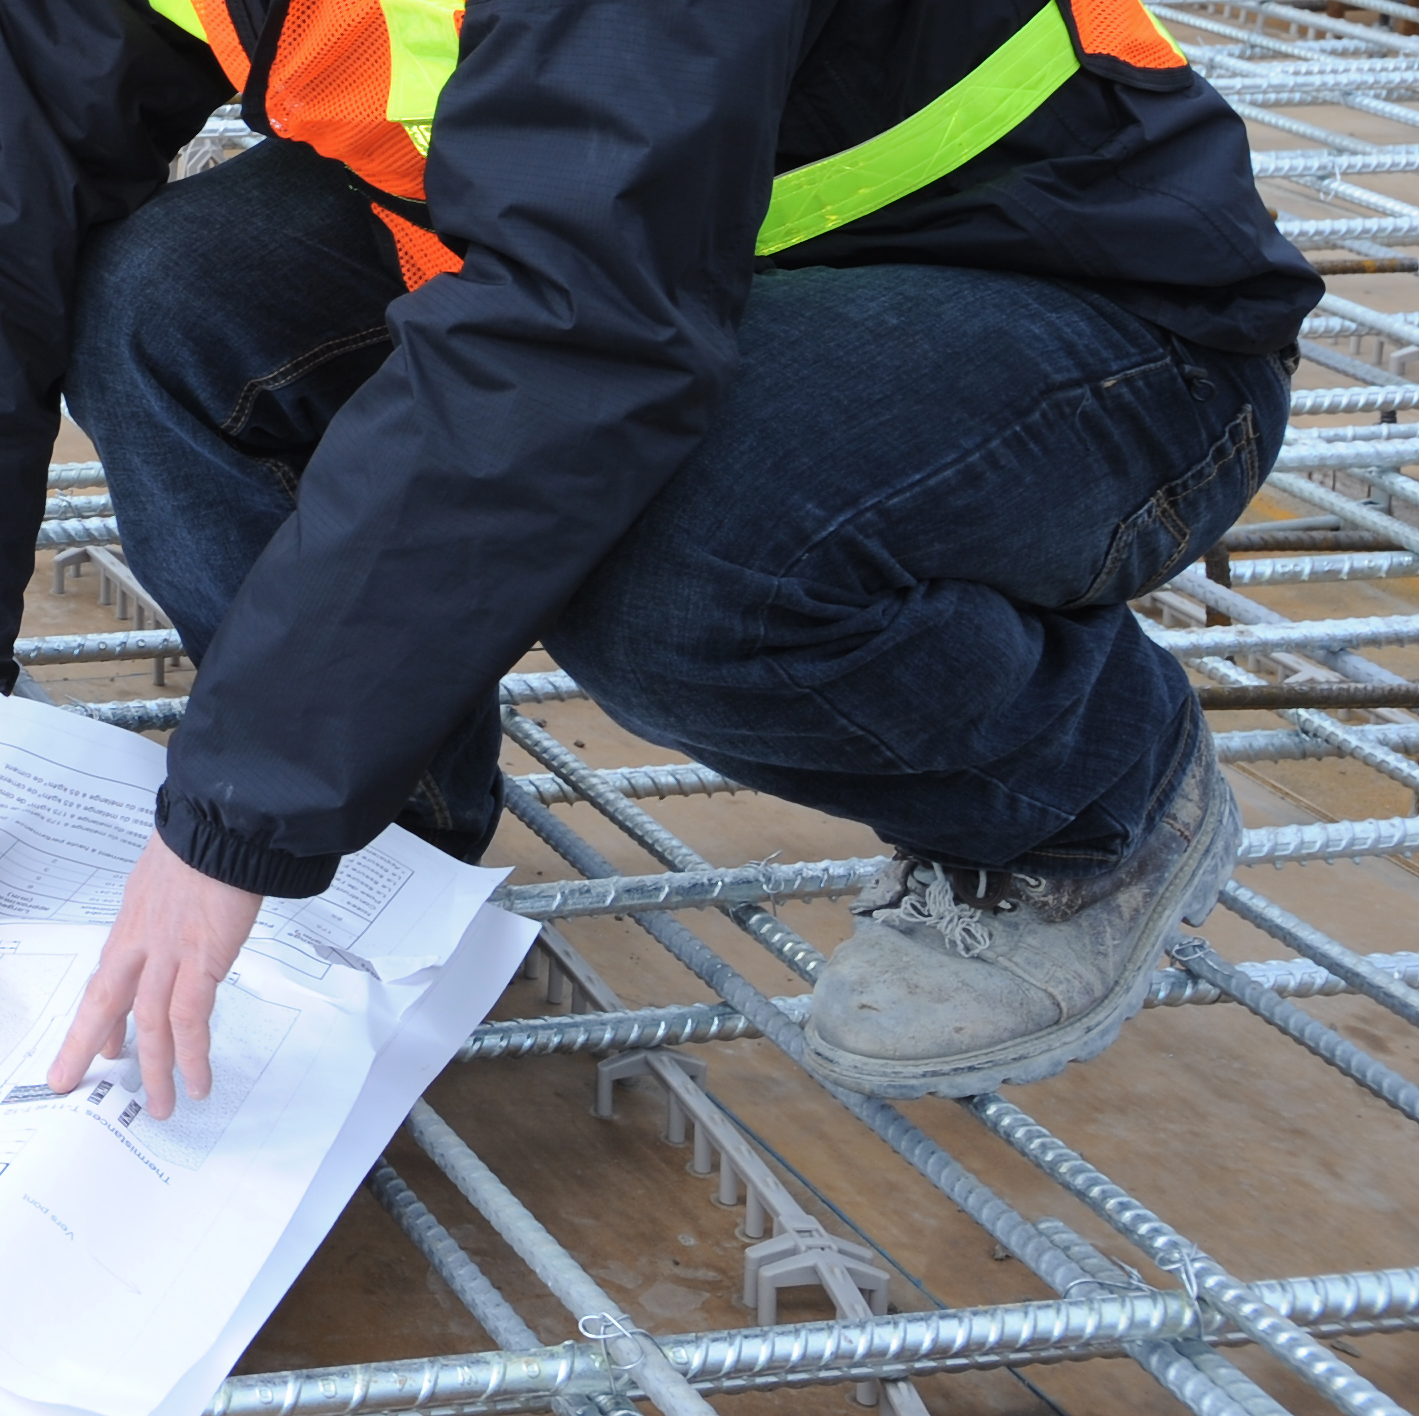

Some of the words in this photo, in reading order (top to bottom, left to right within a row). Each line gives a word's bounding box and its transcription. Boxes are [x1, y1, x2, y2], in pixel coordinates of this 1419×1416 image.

[4, 763, 32, 778] ciment
[86, 1109, 170, 1185] Thermistances
[22, 1194, 54, 1219] pont
[51, 1214, 74, 1241] Vers
